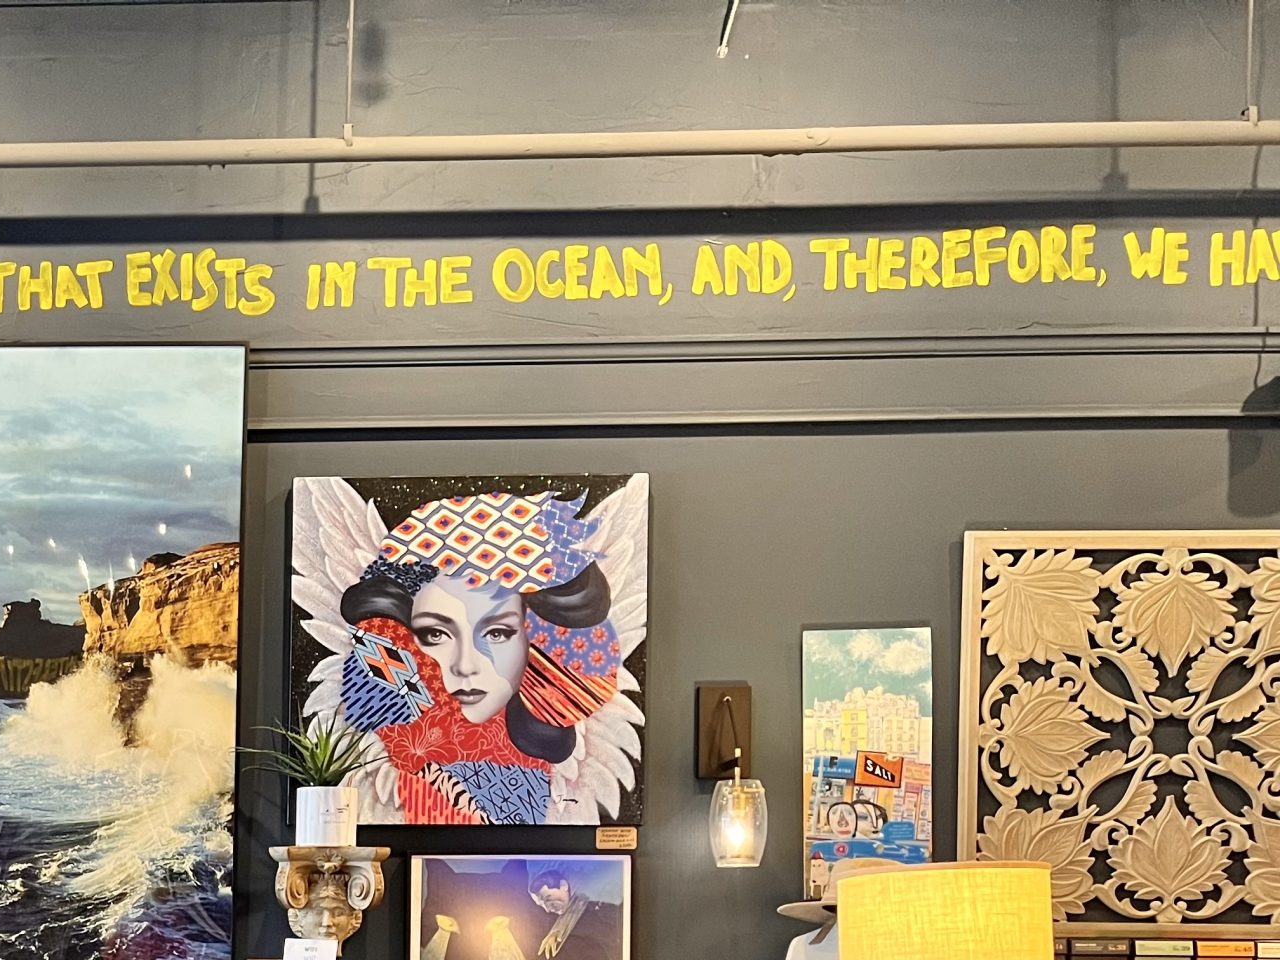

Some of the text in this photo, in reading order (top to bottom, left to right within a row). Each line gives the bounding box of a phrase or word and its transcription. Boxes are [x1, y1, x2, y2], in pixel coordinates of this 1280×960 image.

[126, 248, 276, 317] EXISTS
[306, 261, 358, 311] IN
[368, 255, 474, 308] THE
[492, 243, 674, 306] OCEAN,
[691, 239, 797, 303] AND,
[810, 224, 1108, 295] THEREFORE,
[1123, 227, 1190, 286] WE
[1209, 228, 1280, 288] HA
[865, 759, 892, 781] SALT
